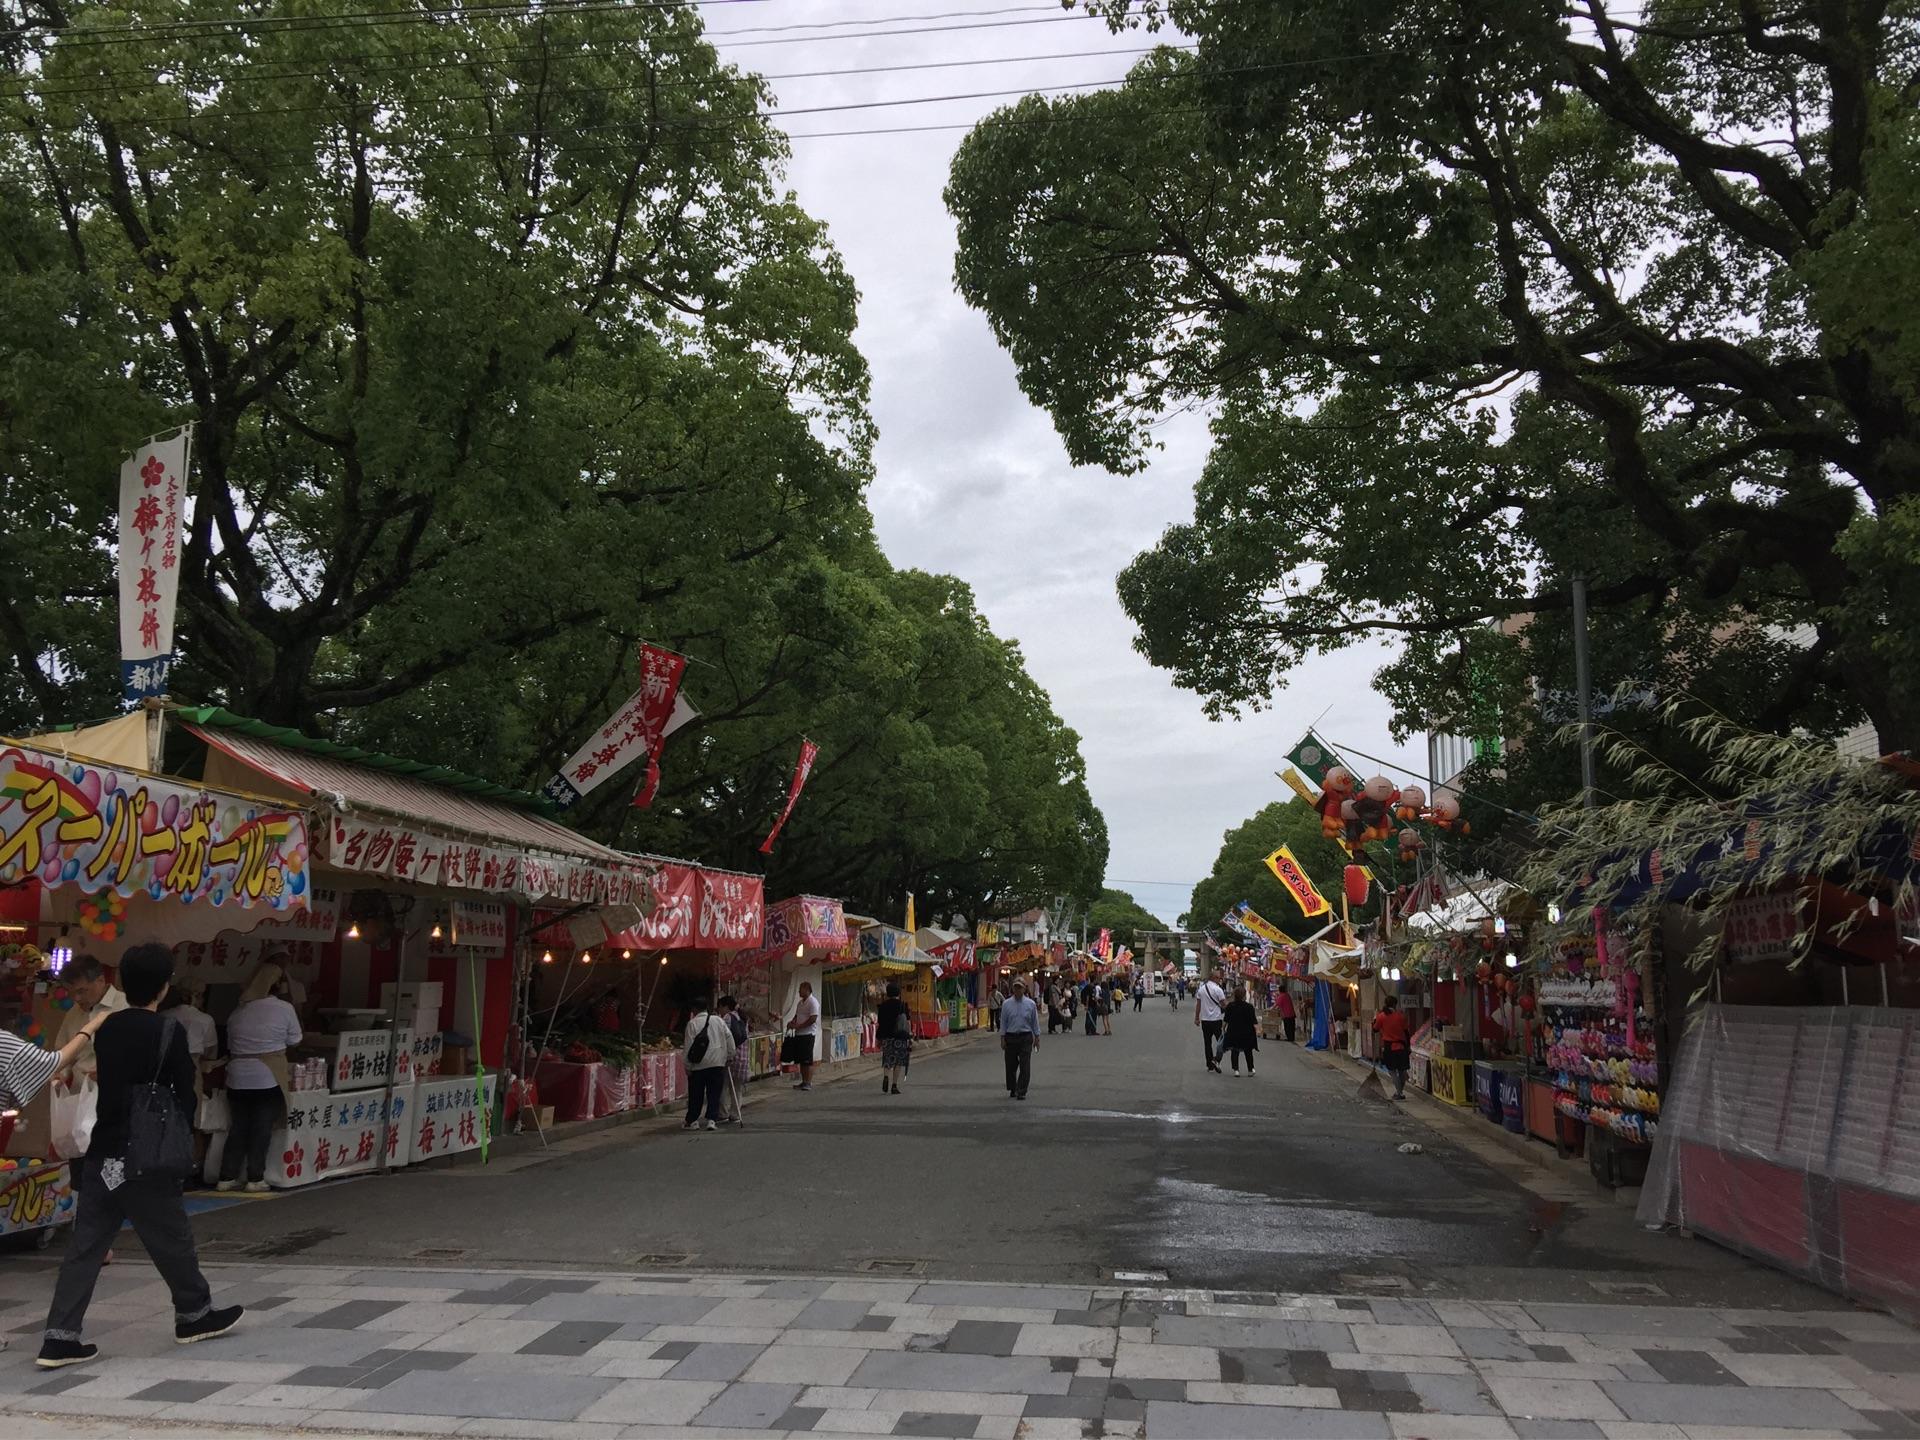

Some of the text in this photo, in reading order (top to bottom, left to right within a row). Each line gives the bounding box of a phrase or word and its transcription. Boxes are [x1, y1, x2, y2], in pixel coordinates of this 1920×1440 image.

[0, 778, 275, 898] スーパーボール
[1281, 862, 1316, 910] やきとり
[1499, 1081, 1519, 1106] ZIMA
